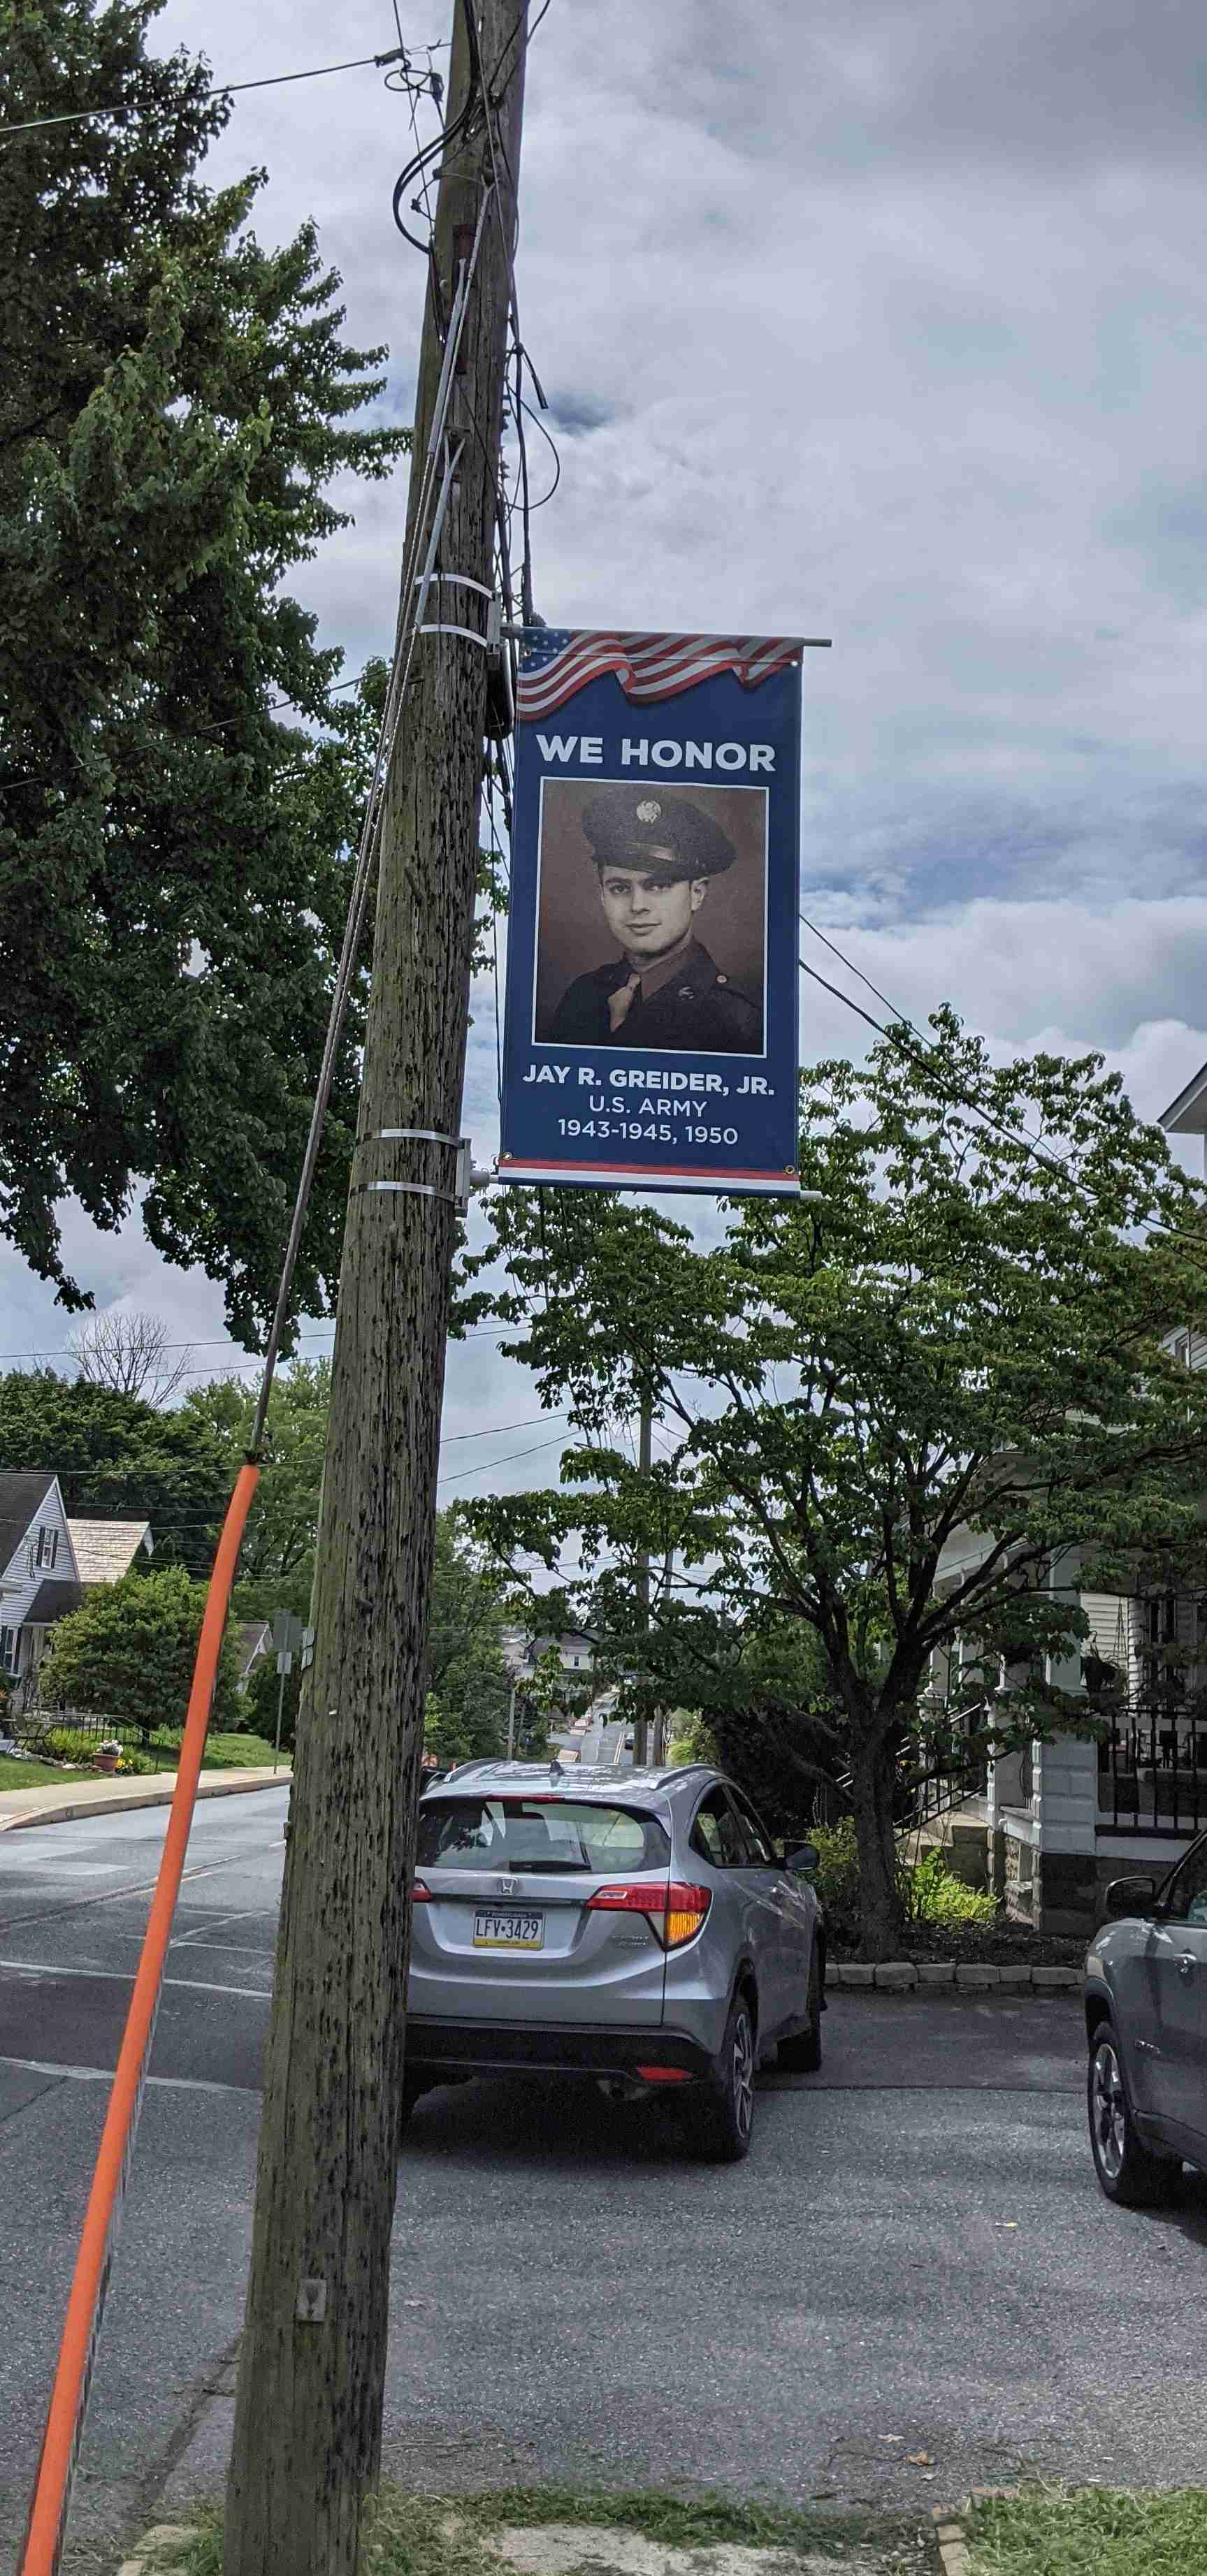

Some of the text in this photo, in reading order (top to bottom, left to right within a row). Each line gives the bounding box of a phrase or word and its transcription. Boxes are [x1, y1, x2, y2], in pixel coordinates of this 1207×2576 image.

[536, 734, 776, 771] WE HONOR
[523, 1065, 775, 1096] JAY R. GREIDER, JR.
[589, 1095, 707, 1118] U.S. ARMY
[558, 1119, 738, 1144] 1943-1945, 1950
